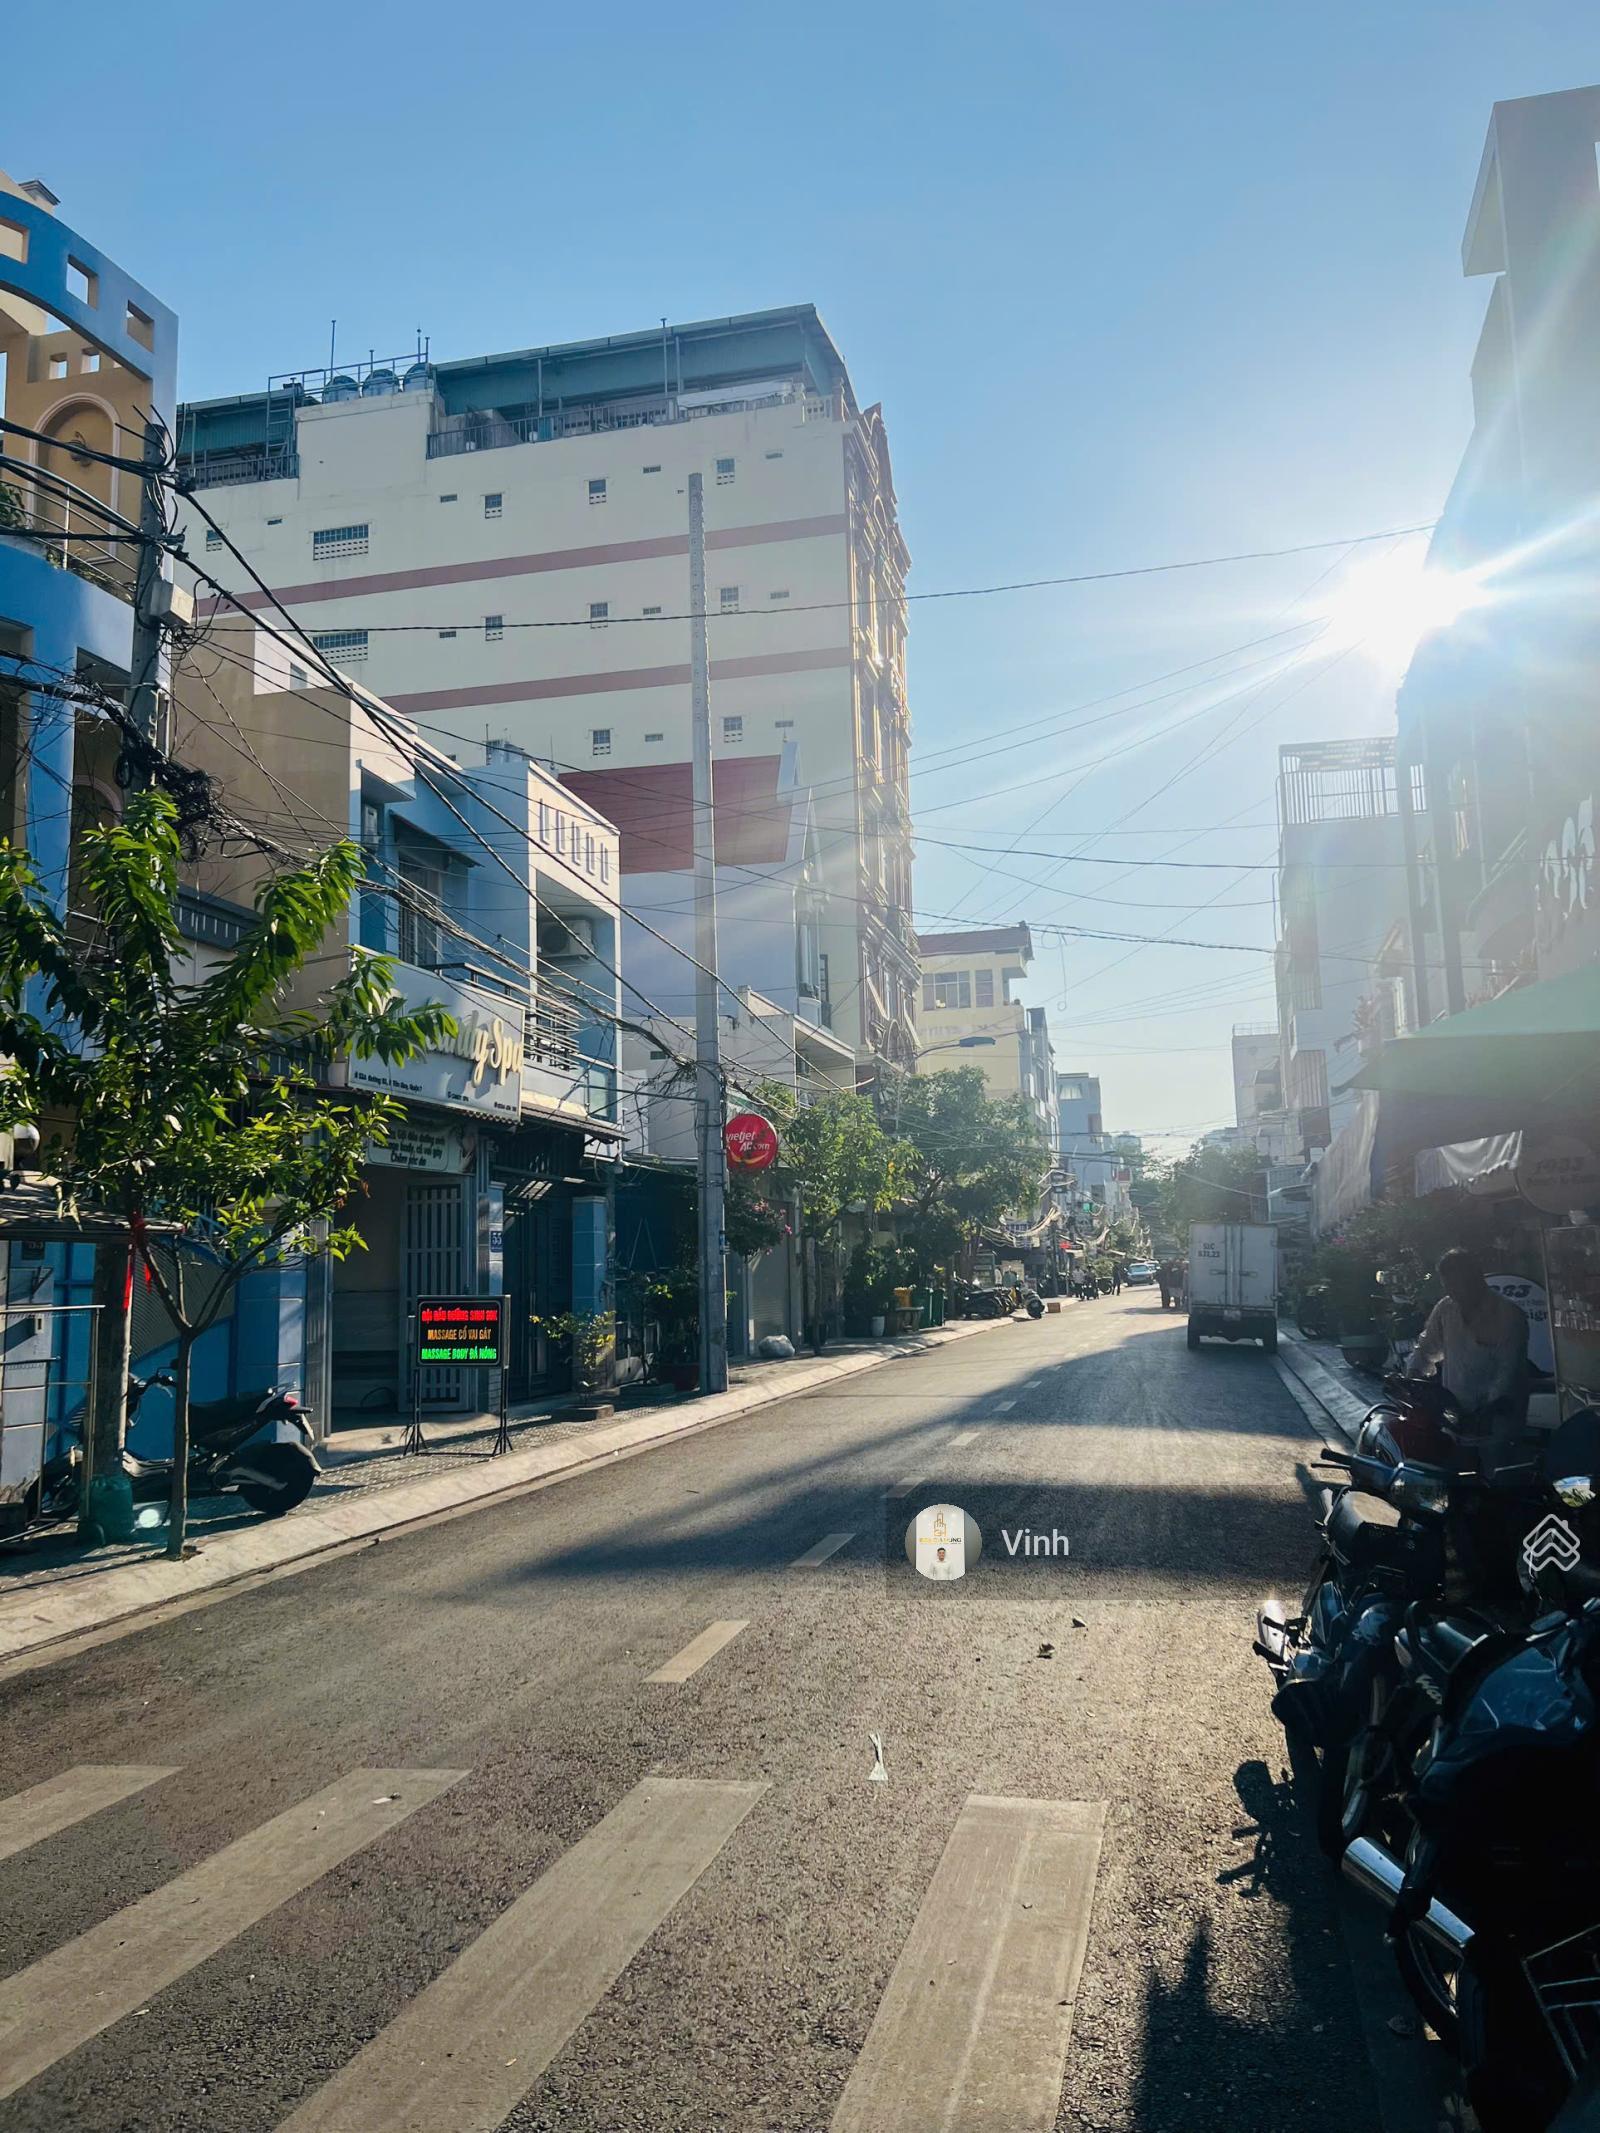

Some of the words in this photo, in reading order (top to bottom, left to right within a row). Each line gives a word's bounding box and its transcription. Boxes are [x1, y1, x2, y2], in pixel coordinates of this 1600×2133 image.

[427, 1329, 458, 1340] MASSAGE
[468, 1329, 478, 1340] VAI
[421, 1348, 452, 1360] MASSAGE
[452, 1348, 469, 1360] BODY
[479, 1346, 497, 1360] NÓNG
